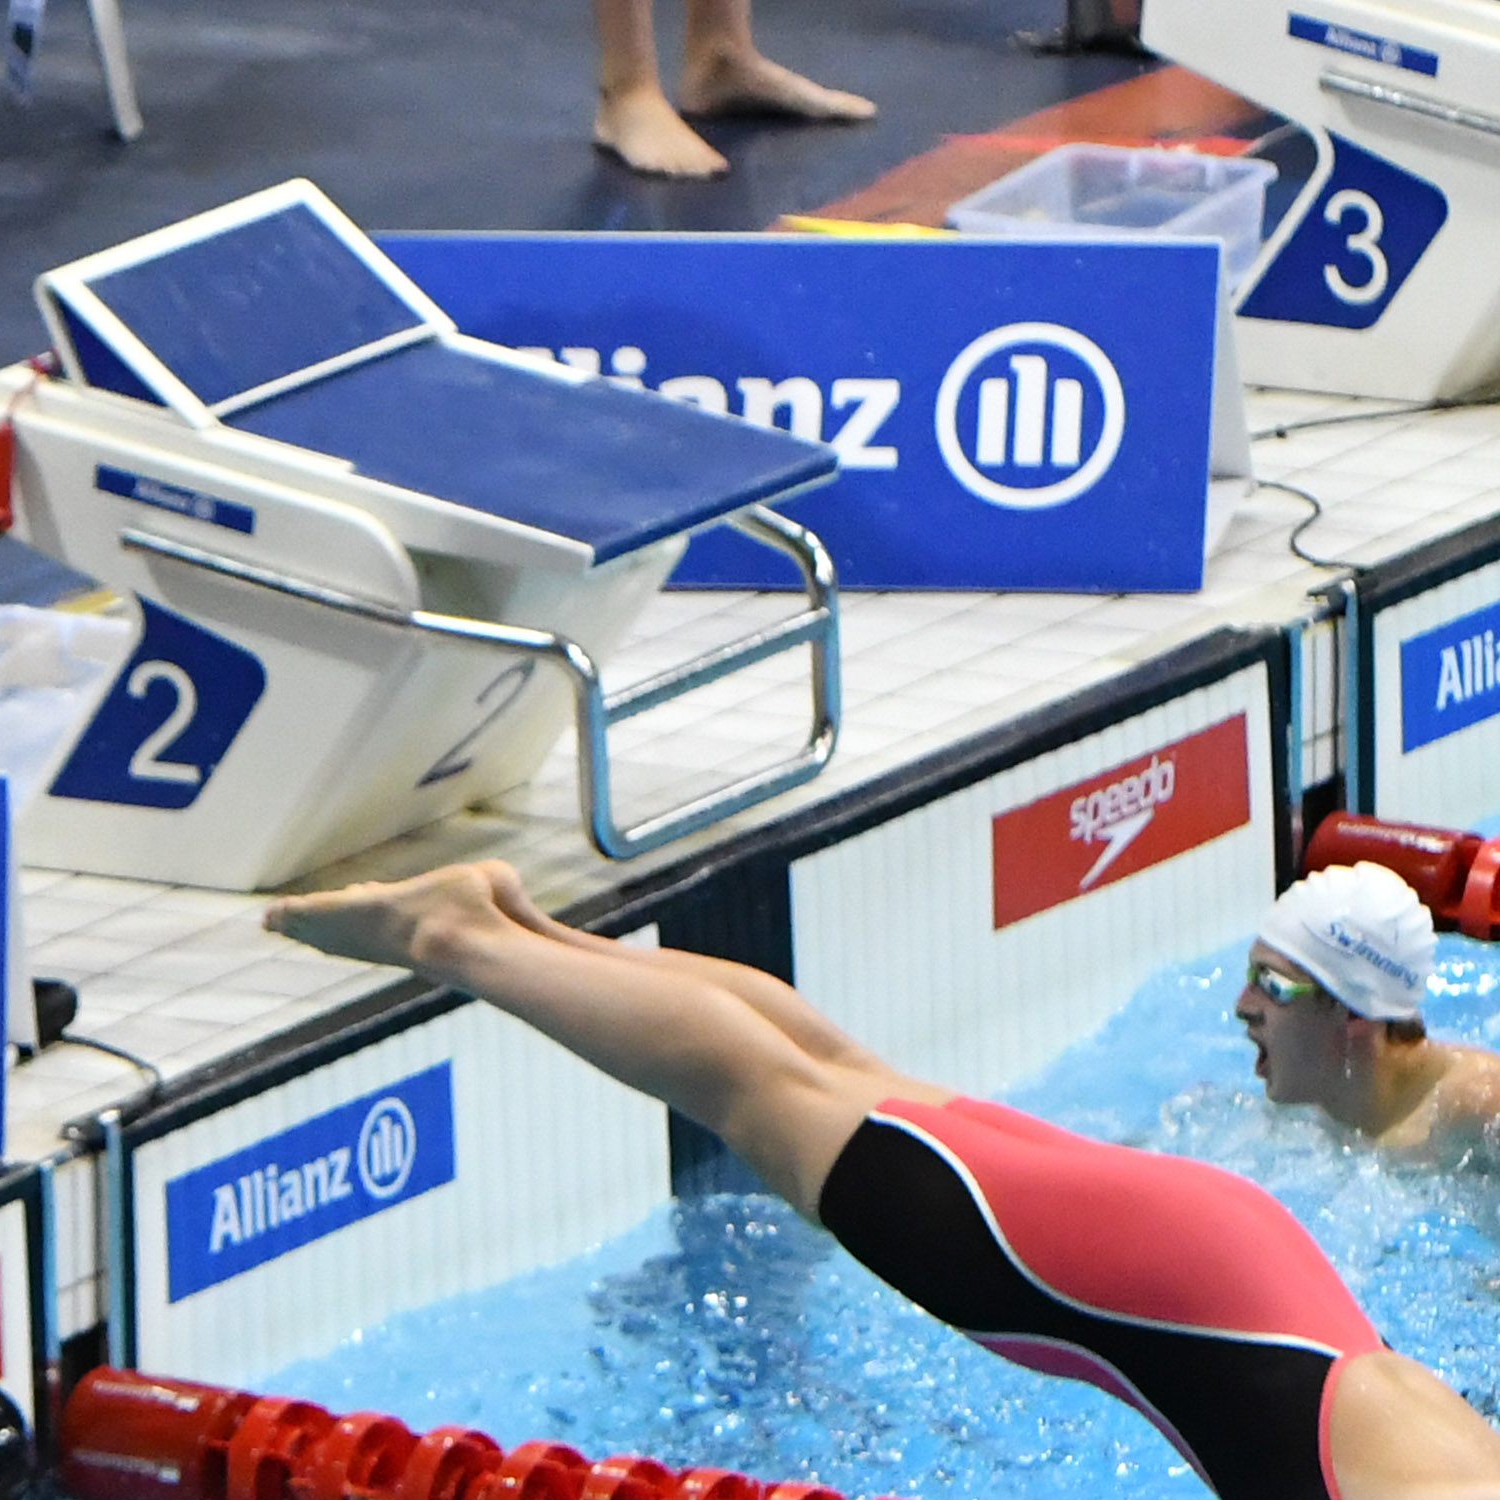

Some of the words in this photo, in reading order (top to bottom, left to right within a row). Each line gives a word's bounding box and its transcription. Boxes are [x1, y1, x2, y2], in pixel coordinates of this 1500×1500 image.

[1322, 188, 1390, 305] 3
[128, 659, 201, 783] 2
[417, 657, 536, 788] 2
[1069, 754, 1176, 845] speedo
[209, 1147, 353, 1254] Allianz
